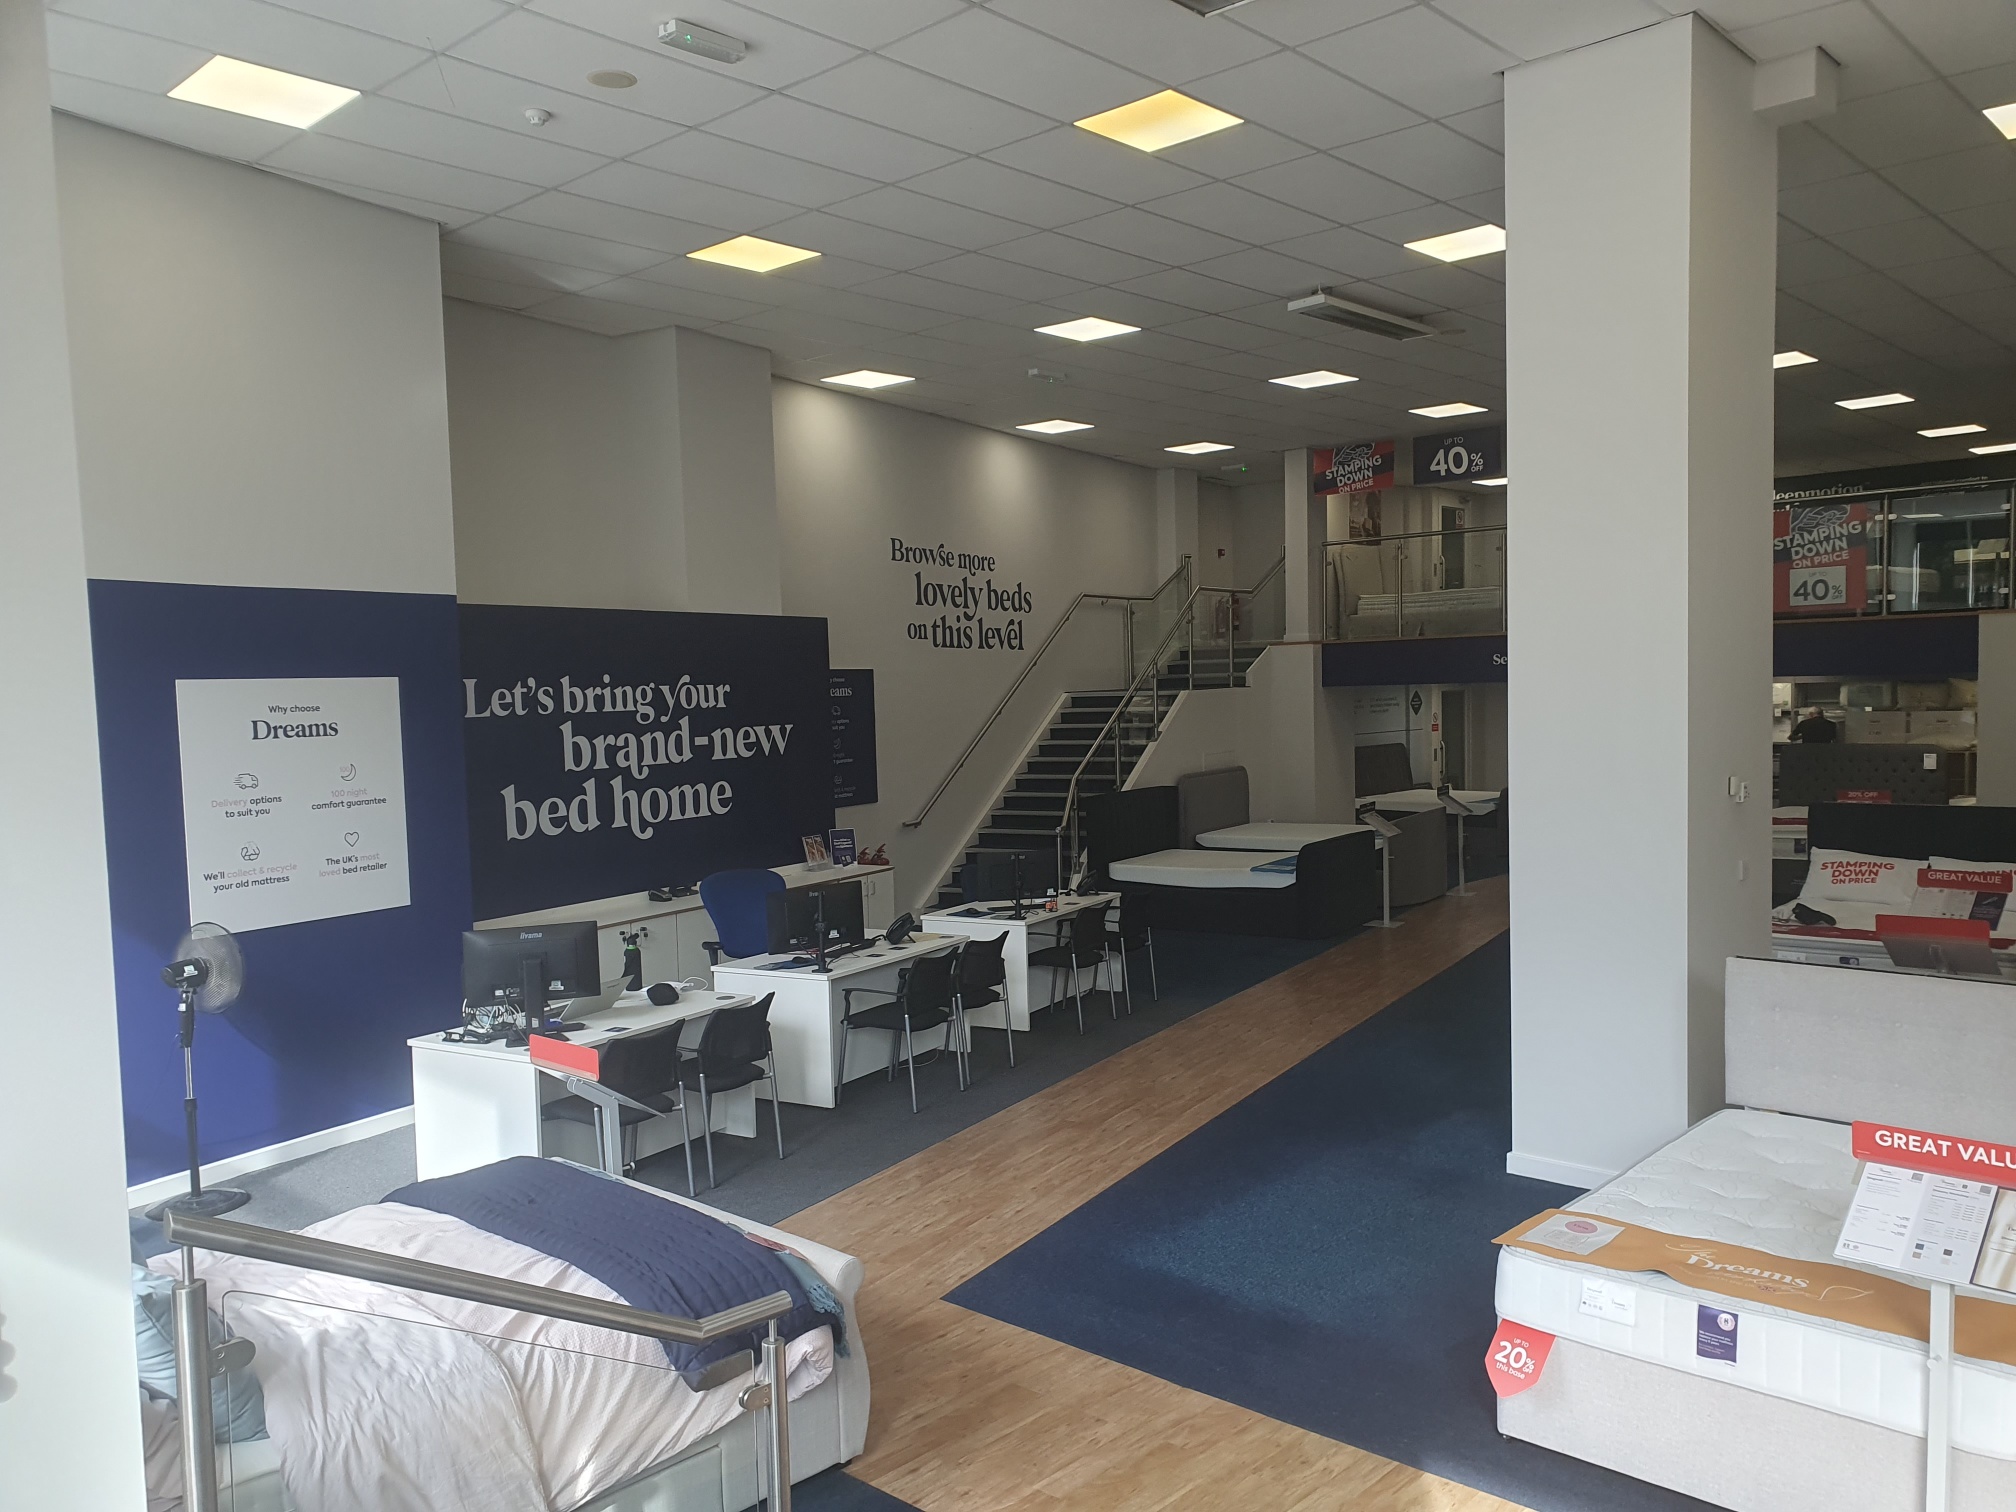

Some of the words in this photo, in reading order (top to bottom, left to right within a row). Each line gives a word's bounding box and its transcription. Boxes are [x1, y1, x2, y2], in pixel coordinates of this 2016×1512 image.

[1326, 454, 1382, 480] STAMPING
[1430, 446, 1484, 476] 40%
[1336, 468, 1373, 487] DOWN
[1339, 486, 1350, 494] ON
[1352, 479, 1374, 492] PRICE
[1774, 521, 1862, 550] STAMPING
[890, 538, 954, 567] Browse
[958, 552, 995, 576] more
[1791, 538, 1848, 560] DOWN
[1792, 556, 1813, 568] ON
[1814, 550, 1850, 566] PRICE
[914, 571, 983, 621] lovely
[986, 579, 1032, 613] beds
[1793, 579, 1842, 601] 40%
[908, 622, 928, 640] on
[931, 615, 972, 649] this
[977, 617, 1024, 650] level
[462, 677, 554, 718] Let's
[560, 674, 654, 724] bring
[658, 674, 730, 722] your
[268, 704, 288, 714] Why
[290, 704, 320, 712] choose
[251, 720, 338, 740] Dreams
[559, 716, 794, 780] brand-new
[211, 798, 247, 808] Delivery
[250, 796, 282, 806] options
[331, 789, 345, 798] 100
[346, 788, 367, 798] night
[237, 808, 253, 817] suit
[254, 808, 270, 818] you
[312, 800, 344, 810] comfort
[346, 797, 387, 808] guarantee
[500, 777, 600, 840] bed
[610, 775, 733, 840] home
[326, 857, 340, 866] The
[360, 852, 380, 861] most
[1820, 861, 1895, 870] STAMPING
[227, 866, 257, 878] collect
[259, 866, 265, 874] &
[266, 863, 298, 874] recycle
[319, 867, 341, 878] loved
[342, 865, 358, 875] bed
[359, 862, 387, 872] retailer
[1832, 869, 1879, 878] DOWN
[1928, 871, 1963, 881] GREAT
[1965, 874, 2002, 884] VALUE
[213, 882, 233, 893] your
[235, 878, 249, 889] old
[251, 874, 290, 887] mattress
[1875, 1130, 1952, 1157] GREAT
[1686, 1255, 1810, 1288] Dreams
[1494, 1340, 1535, 1370] 20%
[1496, 1362, 1508, 1372] this
[1509, 1368, 1525, 1379] base
